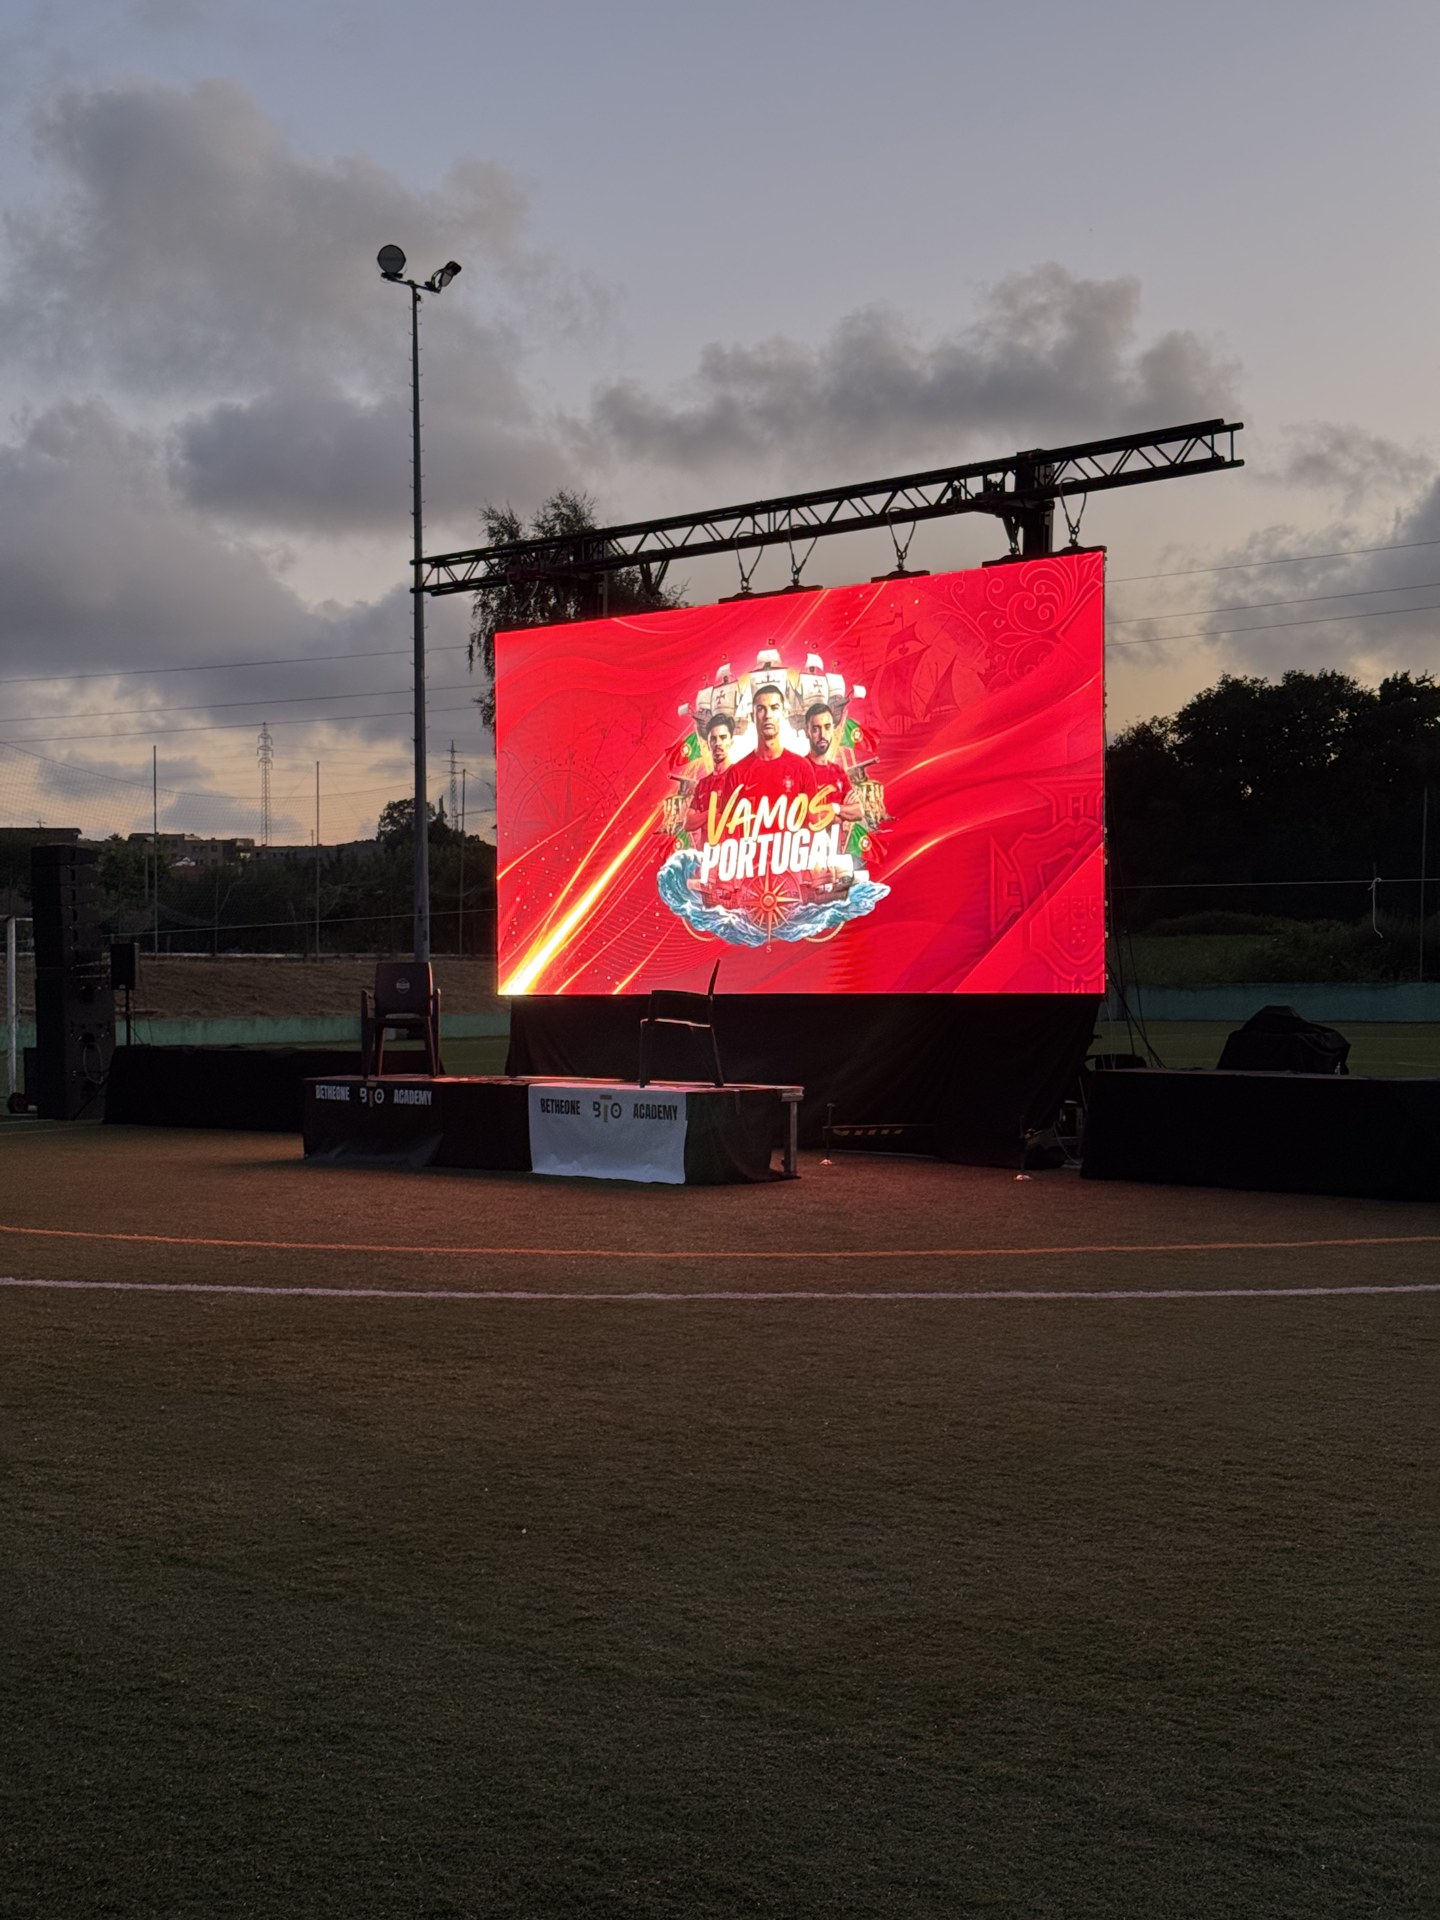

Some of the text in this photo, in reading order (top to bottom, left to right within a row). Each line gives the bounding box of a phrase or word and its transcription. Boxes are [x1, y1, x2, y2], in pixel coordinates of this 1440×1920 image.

[707, 783, 837, 845] VAMOS
[700, 824, 853, 884] PORTUGAL
[393, 1088, 432, 1106] ACADEMY
[540, 1097, 581, 1116] BETHEONE
[633, 1103, 678, 1121] ACADEMY
